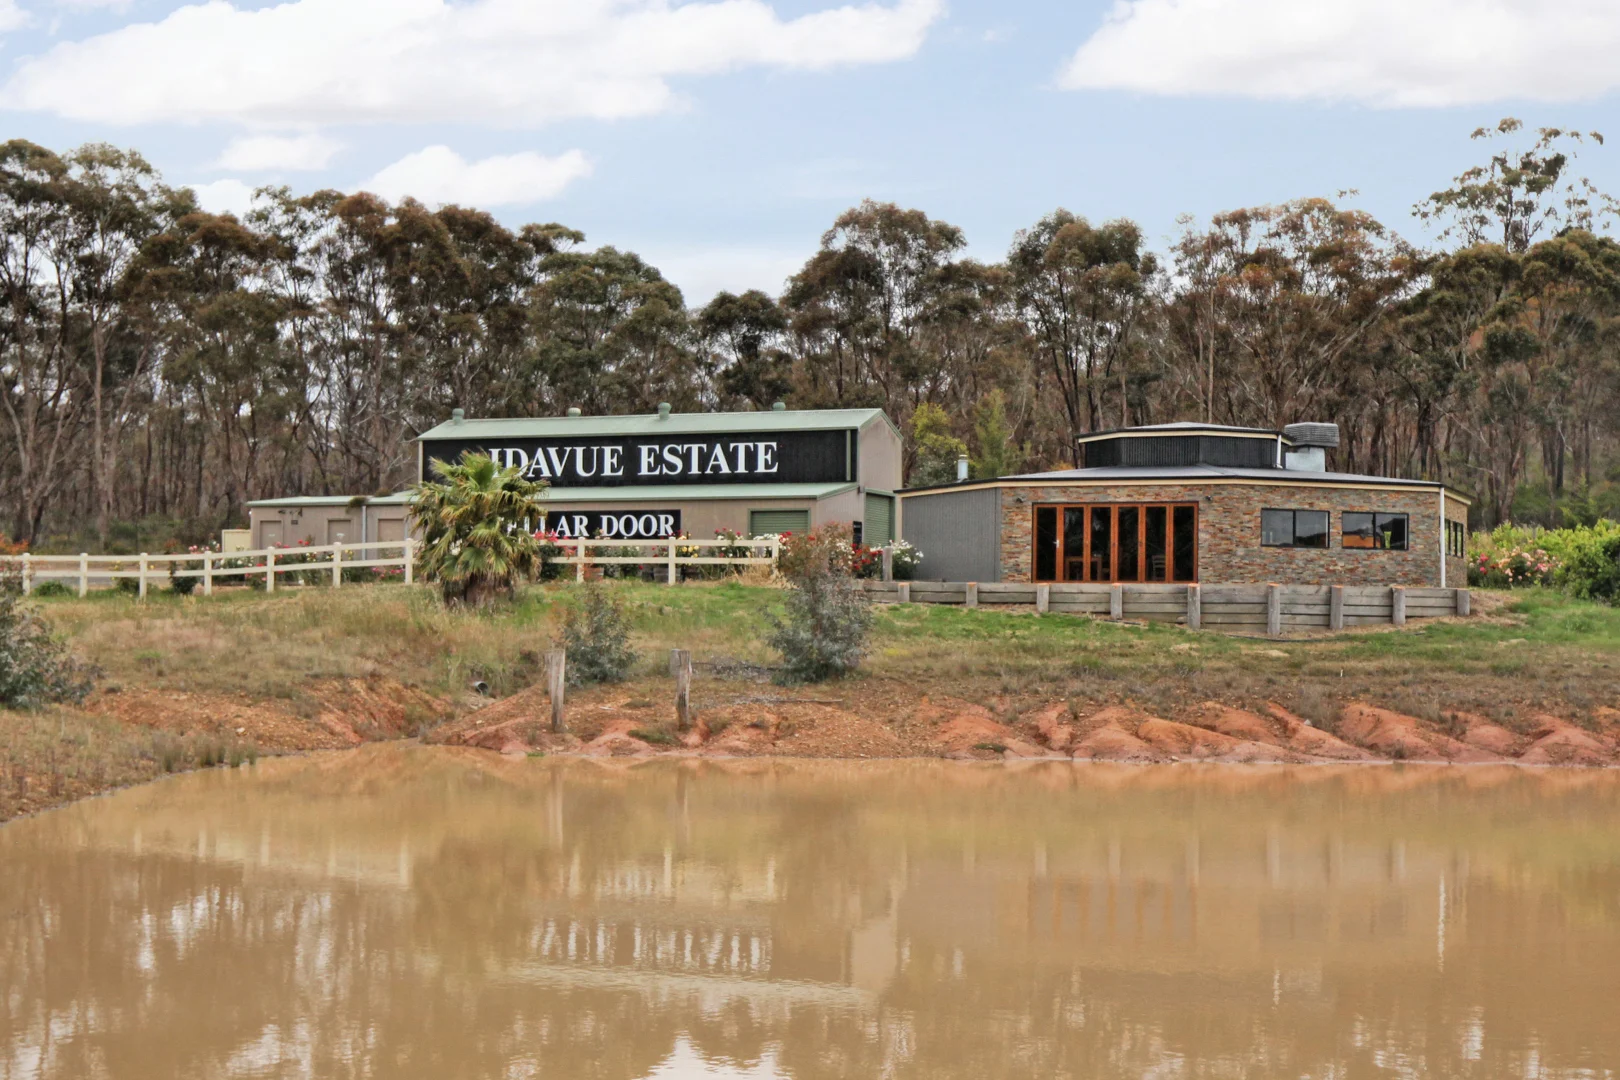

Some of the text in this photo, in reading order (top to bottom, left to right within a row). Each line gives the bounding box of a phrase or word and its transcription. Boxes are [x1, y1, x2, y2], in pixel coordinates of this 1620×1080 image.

[488, 441, 779, 478] IDAVUE ESTATE
[501, 513, 675, 538] LLAR DOOR
